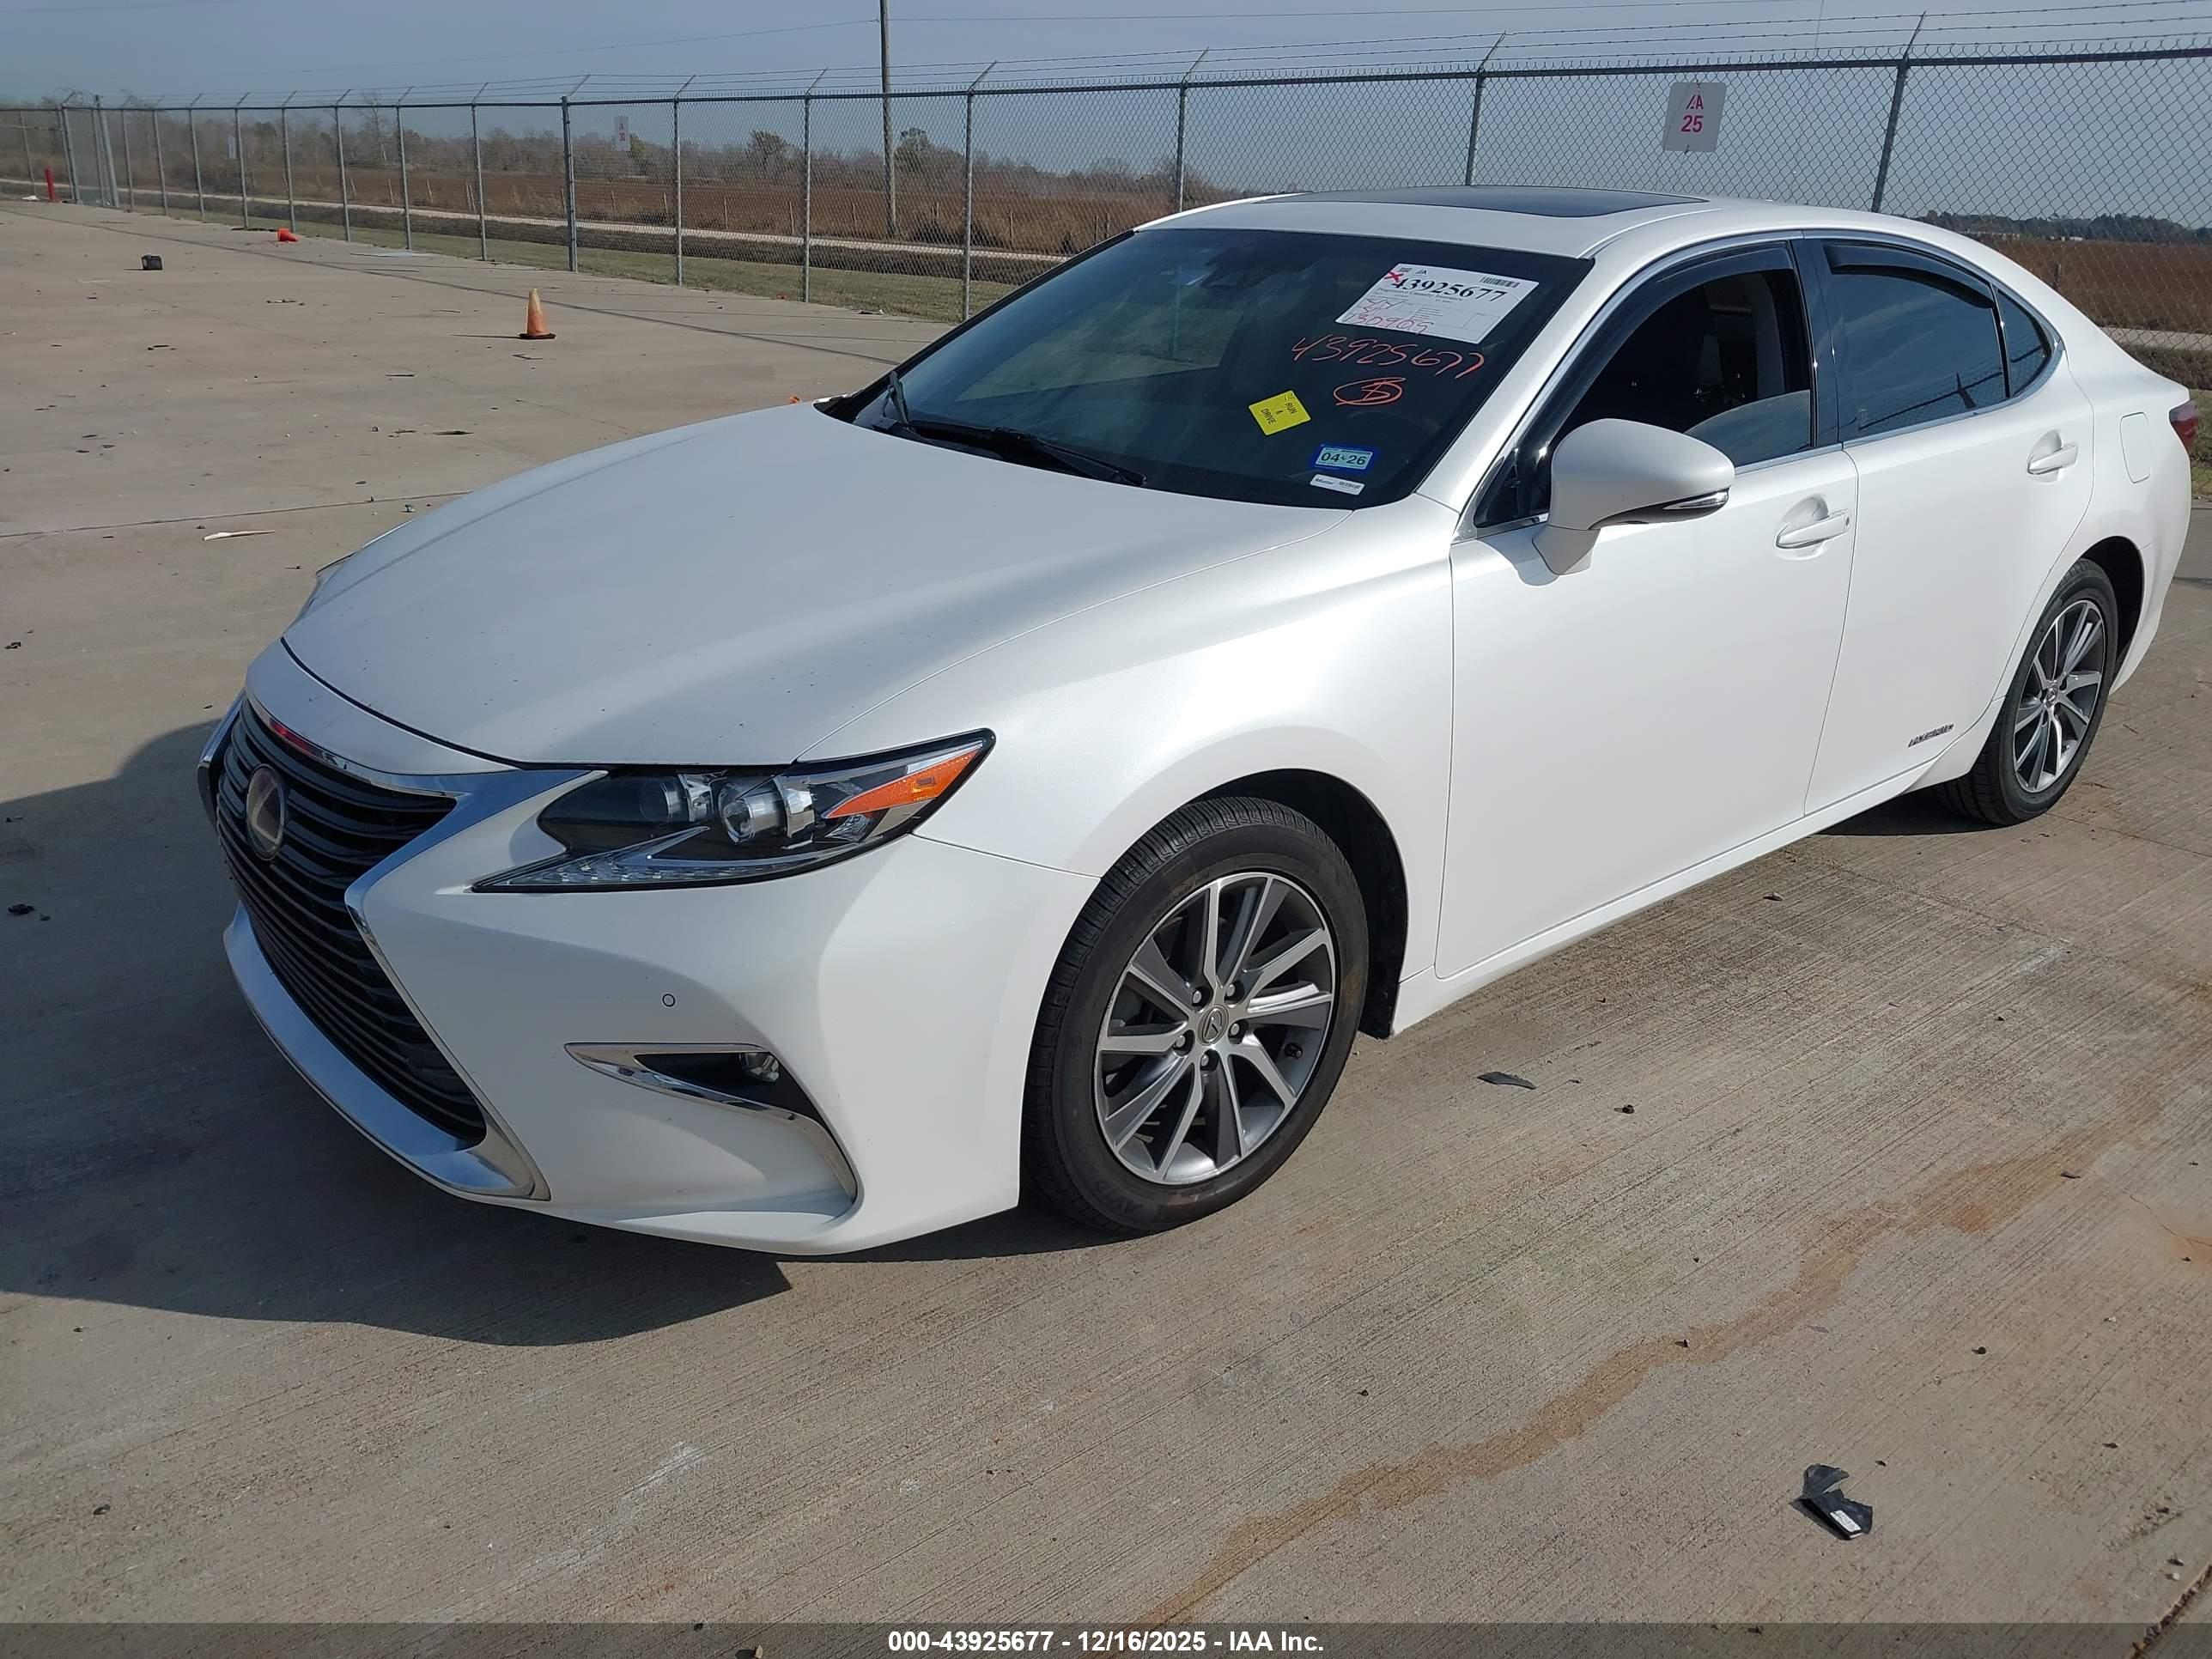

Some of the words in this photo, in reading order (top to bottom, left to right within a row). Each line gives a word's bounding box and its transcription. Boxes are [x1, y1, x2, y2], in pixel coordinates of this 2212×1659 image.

[1681, 114, 1704, 132] 25
[1391, 276, 1509, 302] 43925677
[1291, 333, 1486, 380] 43925677
[1261, 408, 1277, 425] DRIVE
[1285, 402, 1298, 415] RUN
[1321, 452, 1341, 463] 04
[1346, 454, 1367, 465] 26
